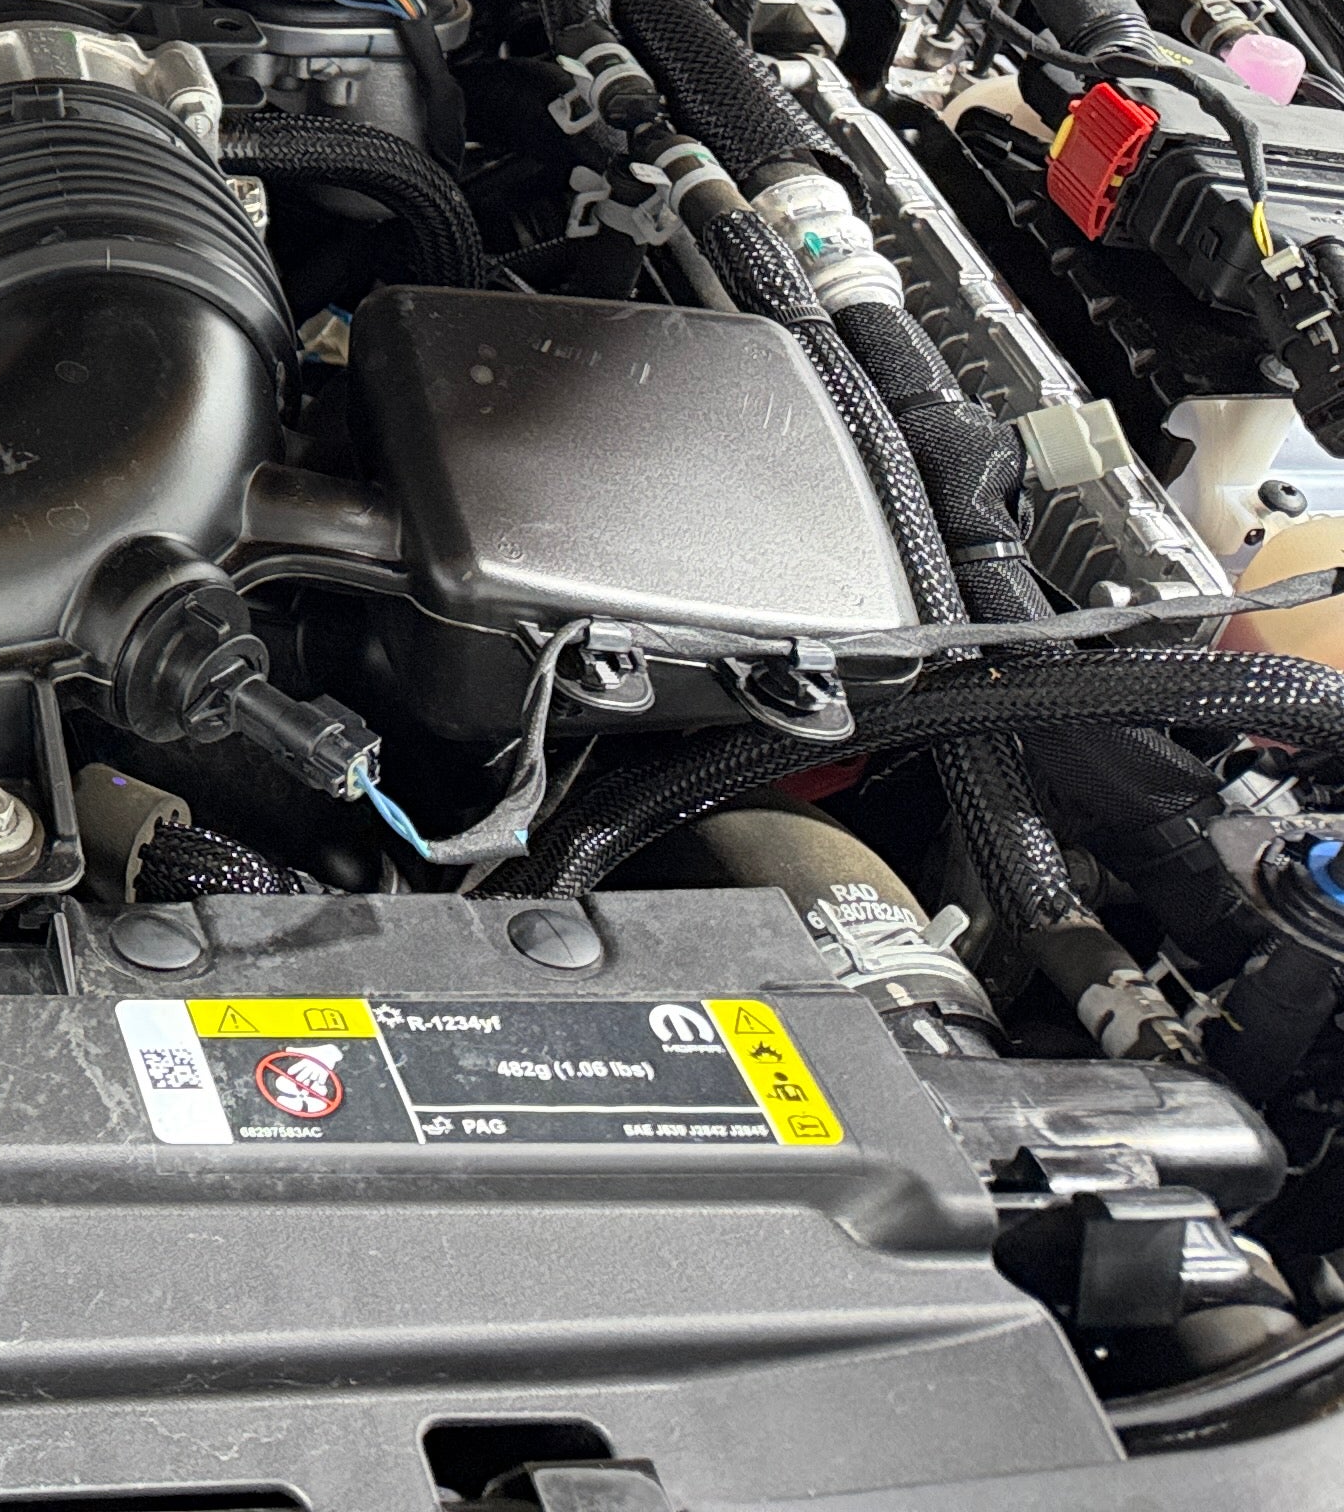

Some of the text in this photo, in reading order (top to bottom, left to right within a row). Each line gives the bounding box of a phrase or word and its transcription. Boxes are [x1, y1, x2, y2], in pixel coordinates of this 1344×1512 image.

[829, 883, 880, 903] RAD
[806, 900, 918, 931] 6280782AD
[407, 1015, 502, 1034] R-1234yf
[496, 1060, 655, 1081] 482g (1.06 lbs)
[461, 1118, 508, 1135] PAG
[622, 1124, 655, 1137] SAE
